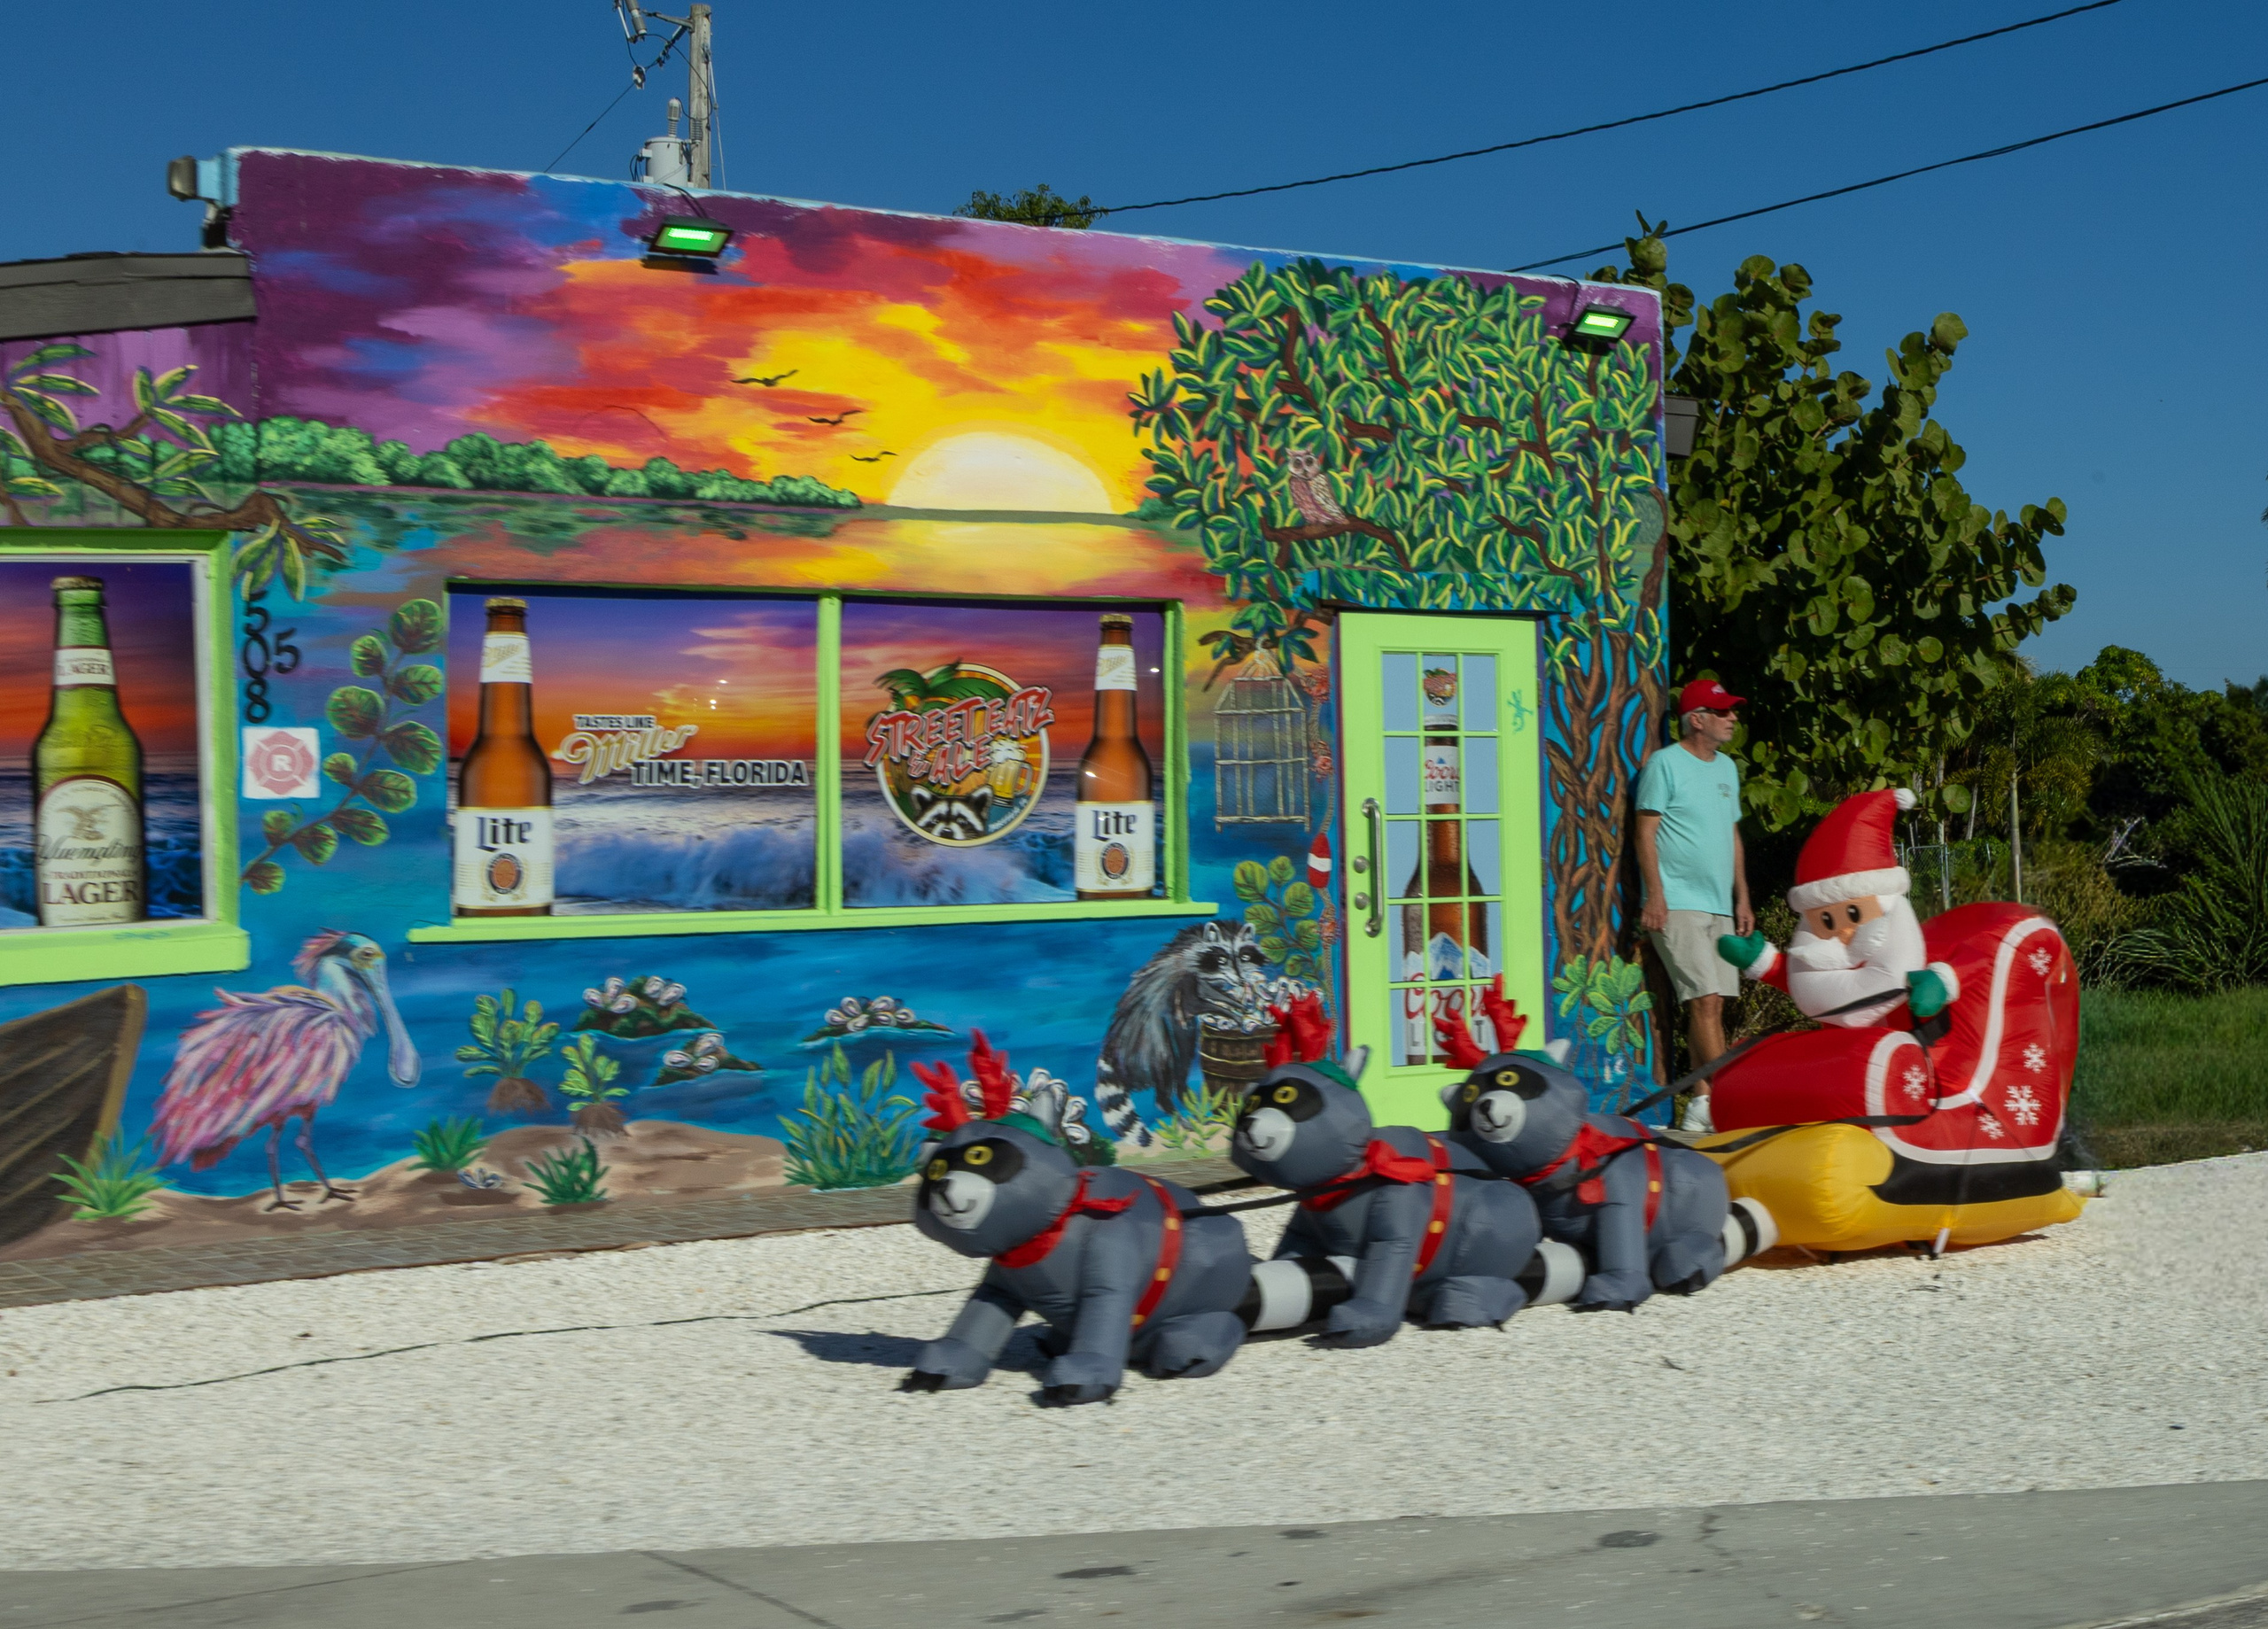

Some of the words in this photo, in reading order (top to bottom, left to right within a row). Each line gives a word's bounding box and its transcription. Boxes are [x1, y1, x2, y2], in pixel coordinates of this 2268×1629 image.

[573, 715, 623, 729] TASTES
[624, 715, 656, 729] LIKE
[863, 696, 985, 768] STREET
[984, 687, 1055, 738] EATZ
[272, 754, 293, 772] R
[560, 725, 699, 785] Miller
[929, 735, 992, 787] ALE
[631, 760, 703, 788] TIME,
[704, 760, 809, 786] FLORIDA
[475, 817, 533, 852] Lite
[1091, 810, 1138, 842] Lite
[43, 880, 139, 904] LAGER
